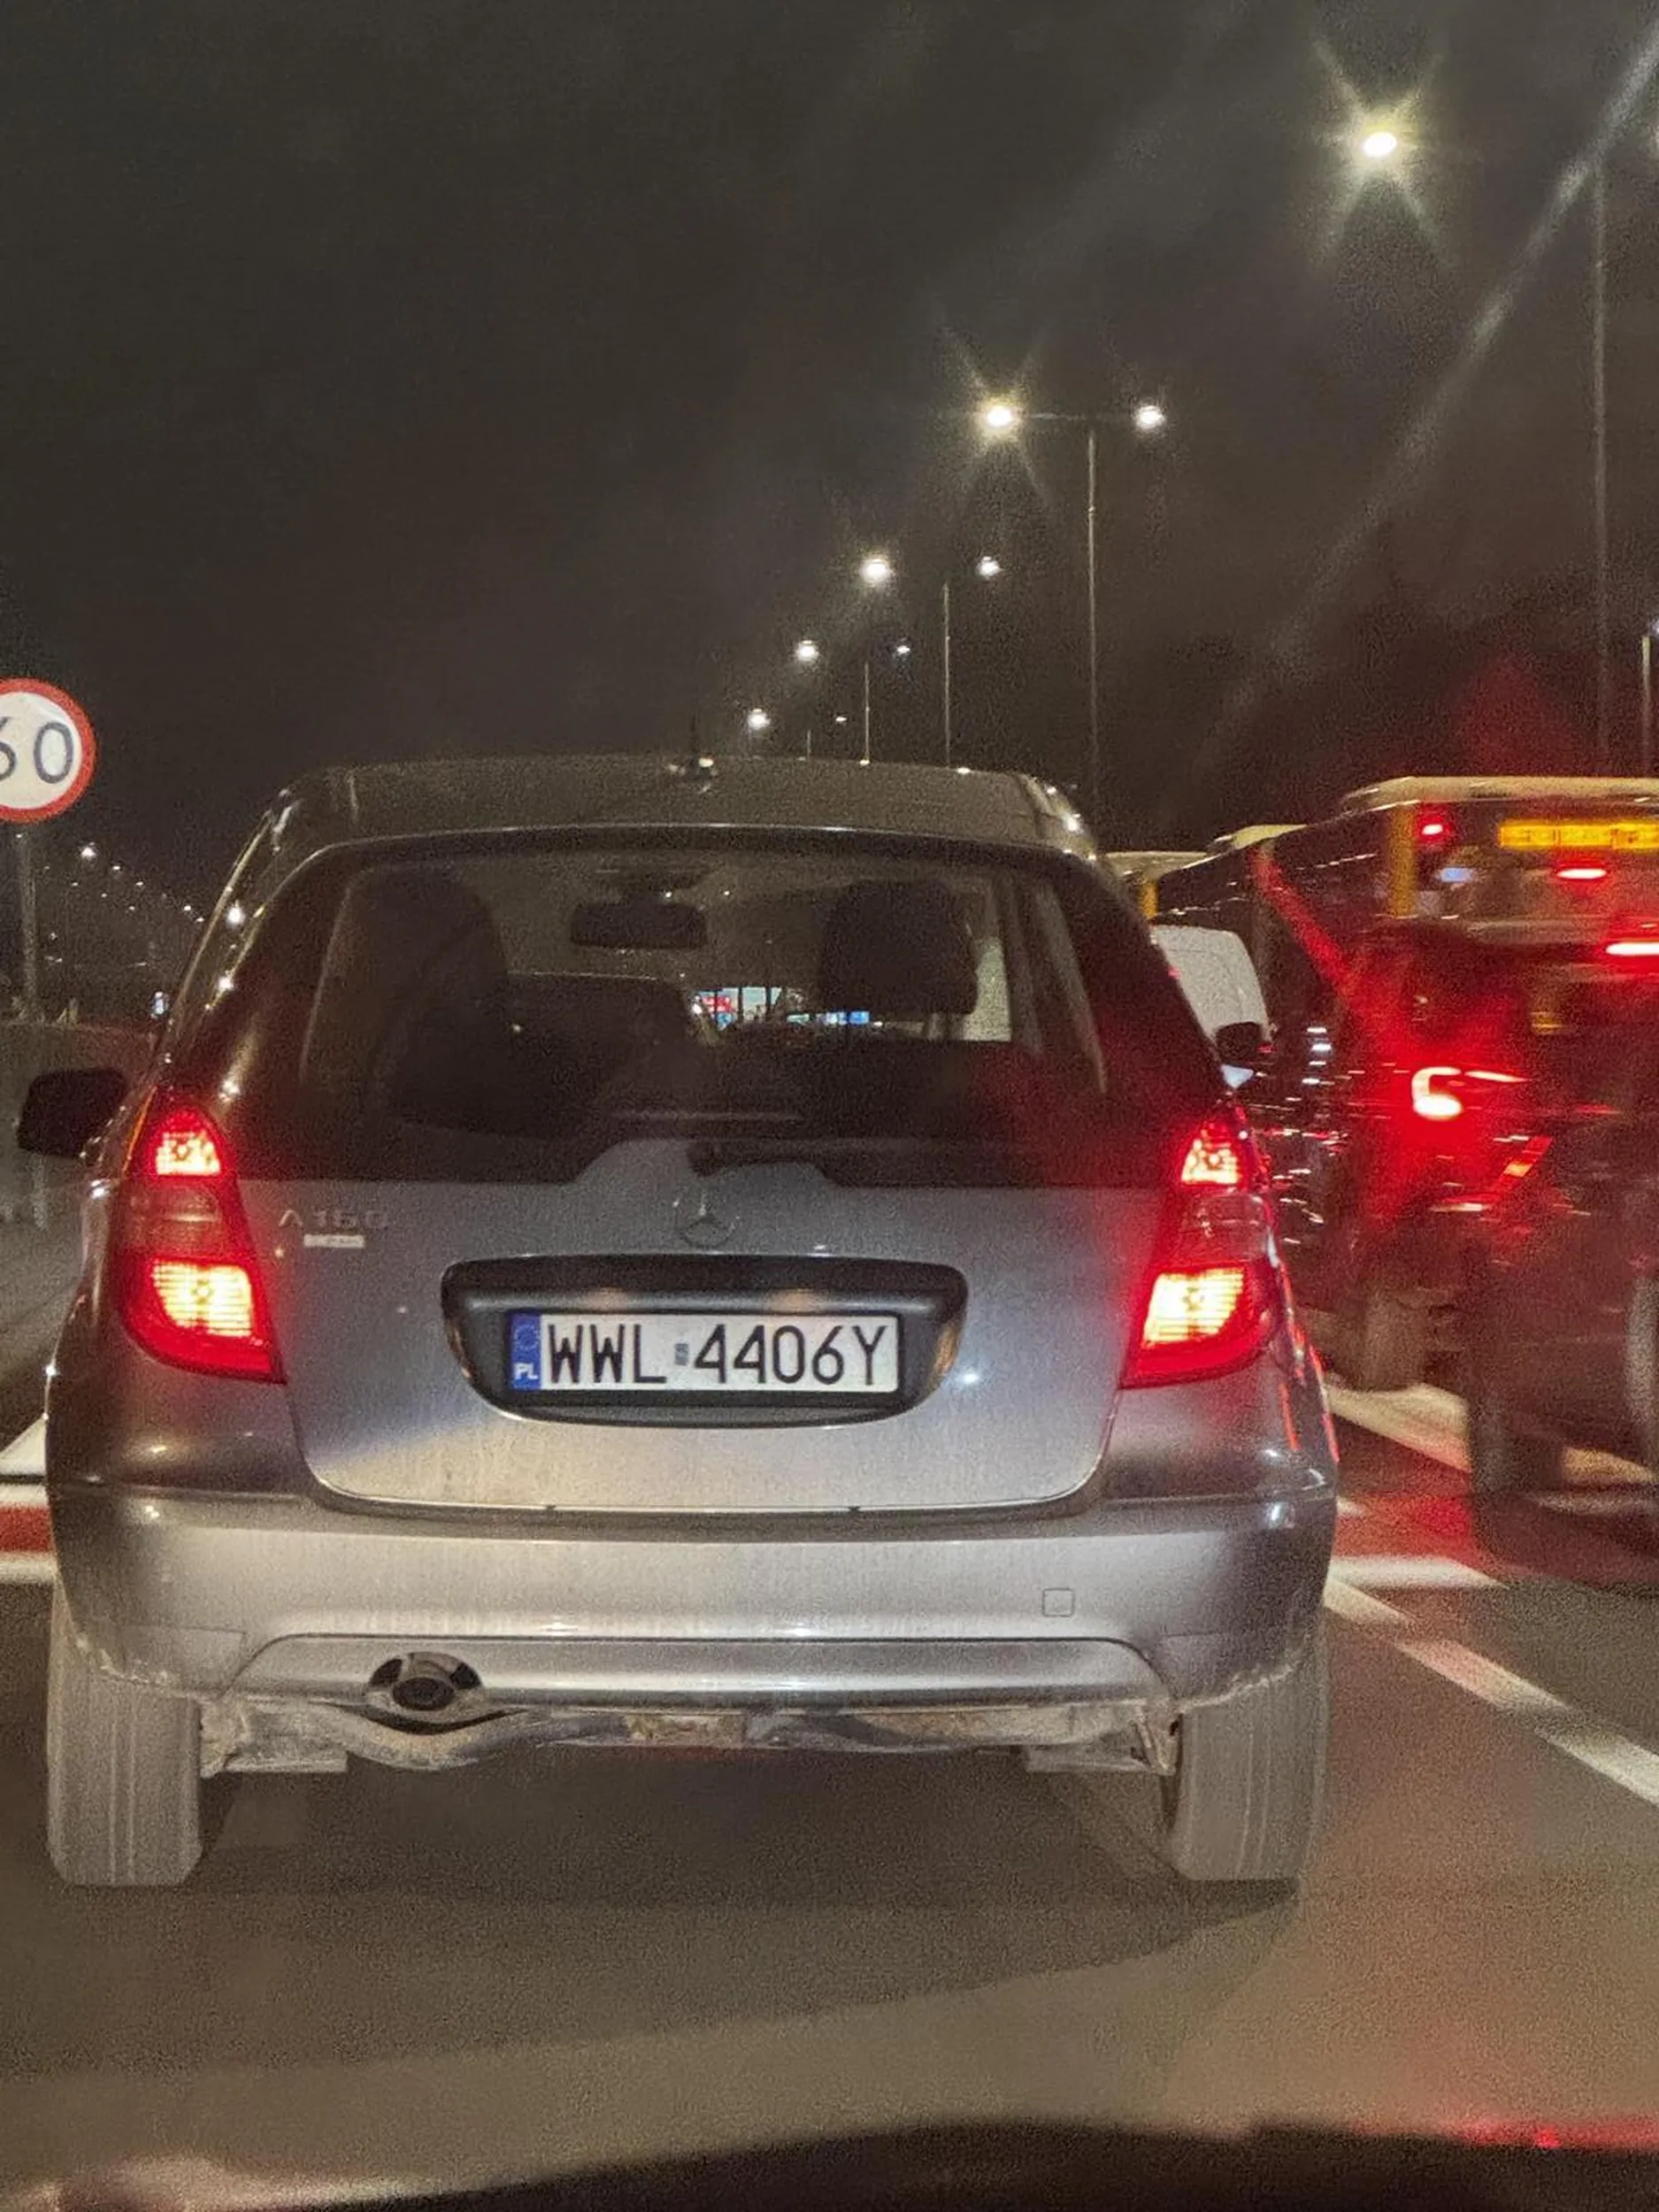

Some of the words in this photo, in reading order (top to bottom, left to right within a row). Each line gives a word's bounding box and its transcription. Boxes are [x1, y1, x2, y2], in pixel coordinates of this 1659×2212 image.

[515, 1363, 538, 1379] PL
[549, 1324, 666, 1383] WWL
[694, 1325, 886, 1385] 4406Y
